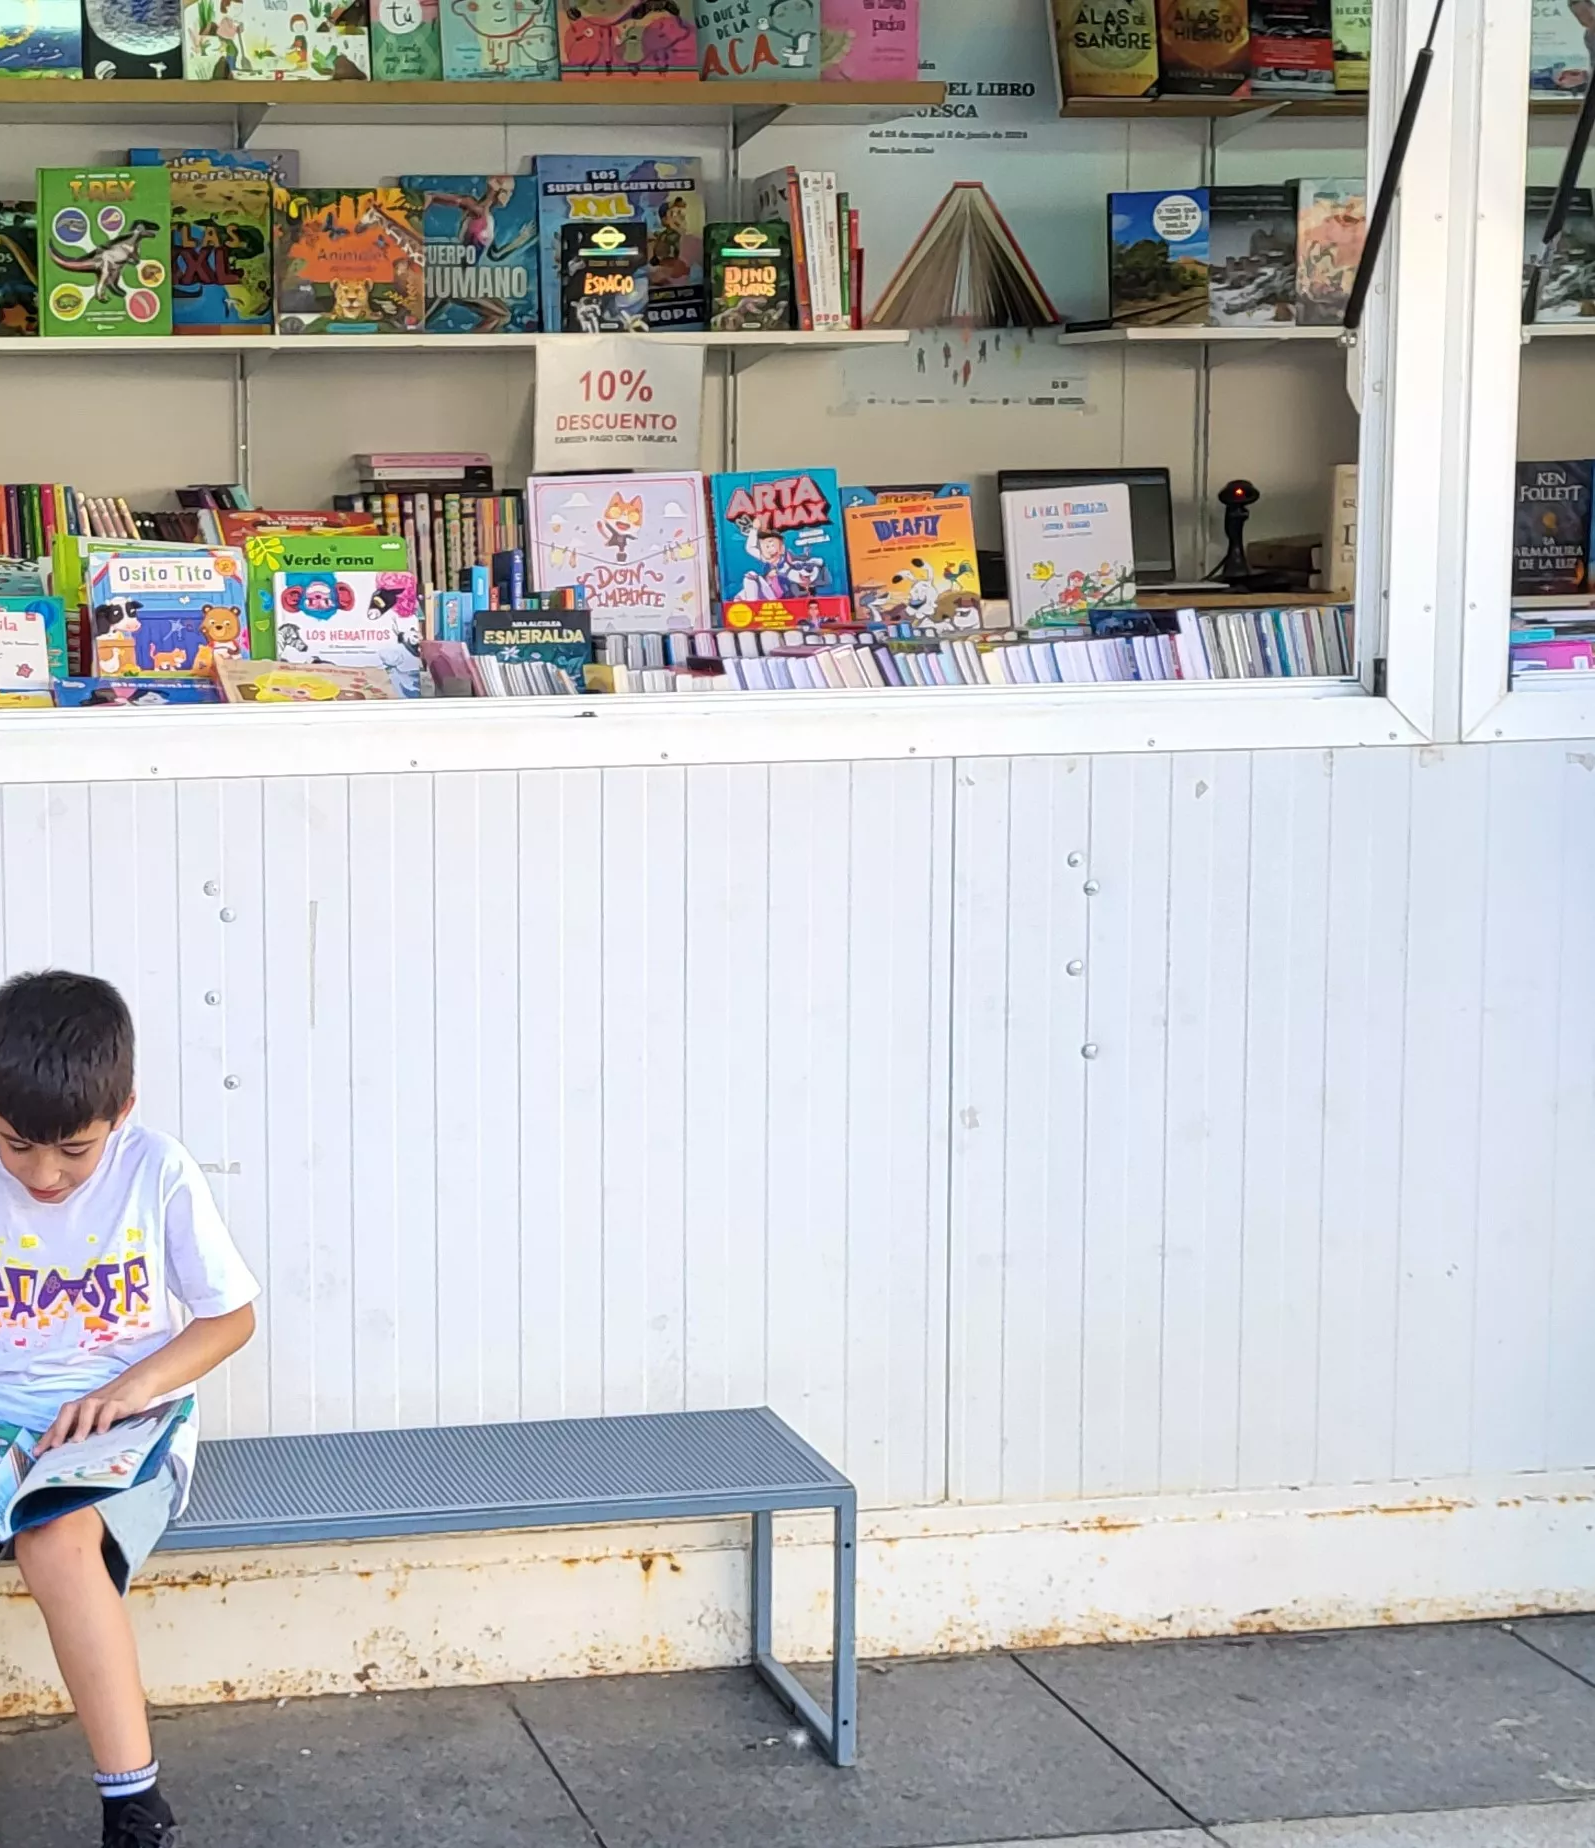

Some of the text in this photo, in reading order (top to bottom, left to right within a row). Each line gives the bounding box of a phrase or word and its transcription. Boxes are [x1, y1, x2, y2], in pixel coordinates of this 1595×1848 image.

[713, 5, 735, 23] QUE
[1075, 9, 1130, 25] ALAS
[1174, 9, 1220, 23] ALAS
[716, 18, 750, 40] DE LA
[1074, 33, 1152, 49] SANGRE
[946, 82, 1035, 96] EL LIBRO
[590, 171, 616, 181] LOS
[568, 195, 633, 219] XXL
[173, 224, 246, 249] LAS
[725, 266, 777, 286] DINO
[584, 274, 635, 296] ESPACIO
[579, 369, 653, 402] 10%
[556, 413, 677, 431] DESCUENTO
[1537, 472, 1567, 485] KEN
[726, 474, 824, 520] ARTA
[1521, 485, 1583, 502] FOLLETT
[773, 500, 828, 530] MAX
[283, 554, 374, 566] Verde rana
[1519, 559, 1534, 569] DE
[1539, 559, 1553, 569] LA
[119, 565, 212, 582] Osito Tito
[593, 562, 645, 589] DON
[306, 629, 390, 641] LOS HEMATITOS
